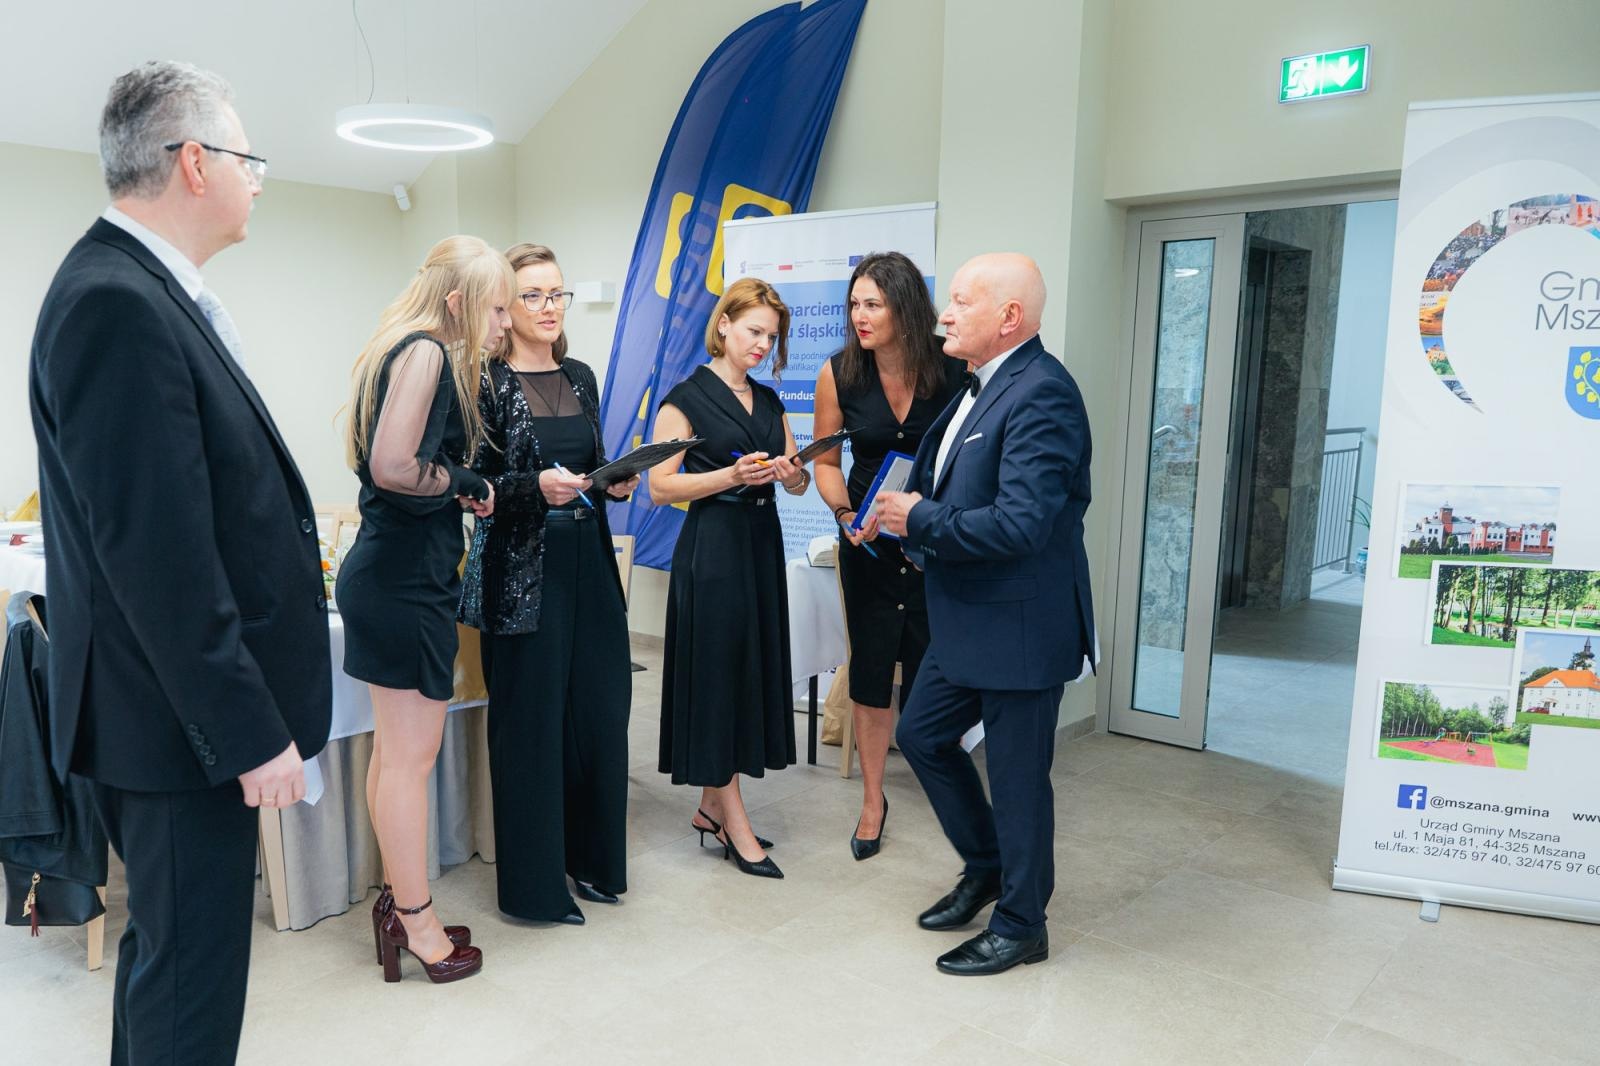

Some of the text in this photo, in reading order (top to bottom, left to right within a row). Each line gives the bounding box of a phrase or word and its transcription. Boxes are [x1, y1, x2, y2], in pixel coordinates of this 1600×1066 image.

[1535, 303, 1600, 330] Msz
[1430, 795, 1550, 818] @mszana.gmina
[1572, 812, 1600, 822] ww
[1420, 818, 1561, 843] Urząd Gminy Mszana
[1374, 840, 1419, 854] tel./fax:
[1423, 845, 1467, 860] 32/475
[1471, 851, 1487, 862] 97
[1516, 856, 1562, 871] 32/475
[1566, 862, 1582, 873] 97
[1393, 829, 1586, 860] ul. 1 Maja 81, 44-325 Mszana
